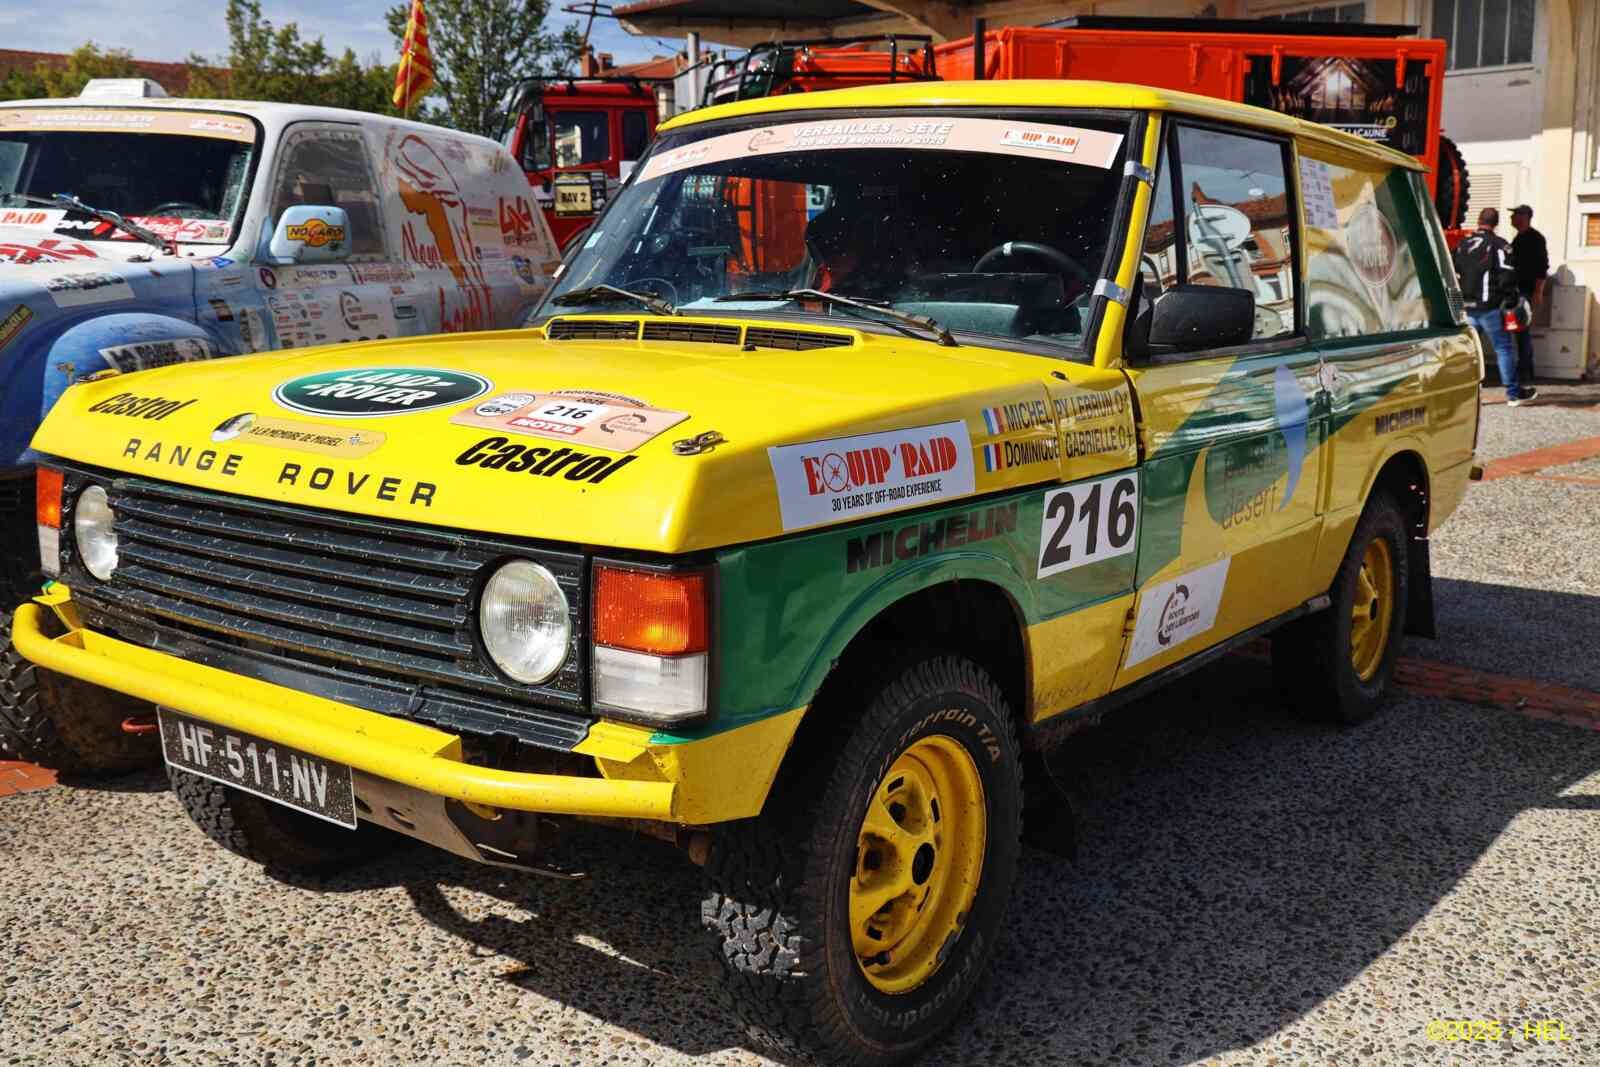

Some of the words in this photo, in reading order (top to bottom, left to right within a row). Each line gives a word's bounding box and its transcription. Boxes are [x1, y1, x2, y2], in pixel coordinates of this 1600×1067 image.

[793, 122, 892, 137] VERSAILLES
[305, 382, 438, 406] ROVER
[334, 371, 441, 387] LAND
[87, 392, 199, 421] Castrol
[543, 405, 593, 420] 216
[1003, 398, 1053, 432] MICHEL
[511, 418, 578, 434] MOTUL
[455, 436, 639, 485] Castrol
[1004, 438, 1059, 468] DOMINIQUE
[1065, 427, 1117, 459] GABRIELLE
[123, 437, 243, 477] RANGE
[277, 462, 437, 507] ROVER
[831, 498, 842, 512] 30
[842, 493, 865, 510] YEARS
[865, 491, 874, 505] OF
[874, 485, 905, 504] OFF-ROAD
[906, 479, 942, 499] EXPERIENCE
[847, 502, 1018, 574] MICHELIN
[1040, 478, 1136, 570] 216
